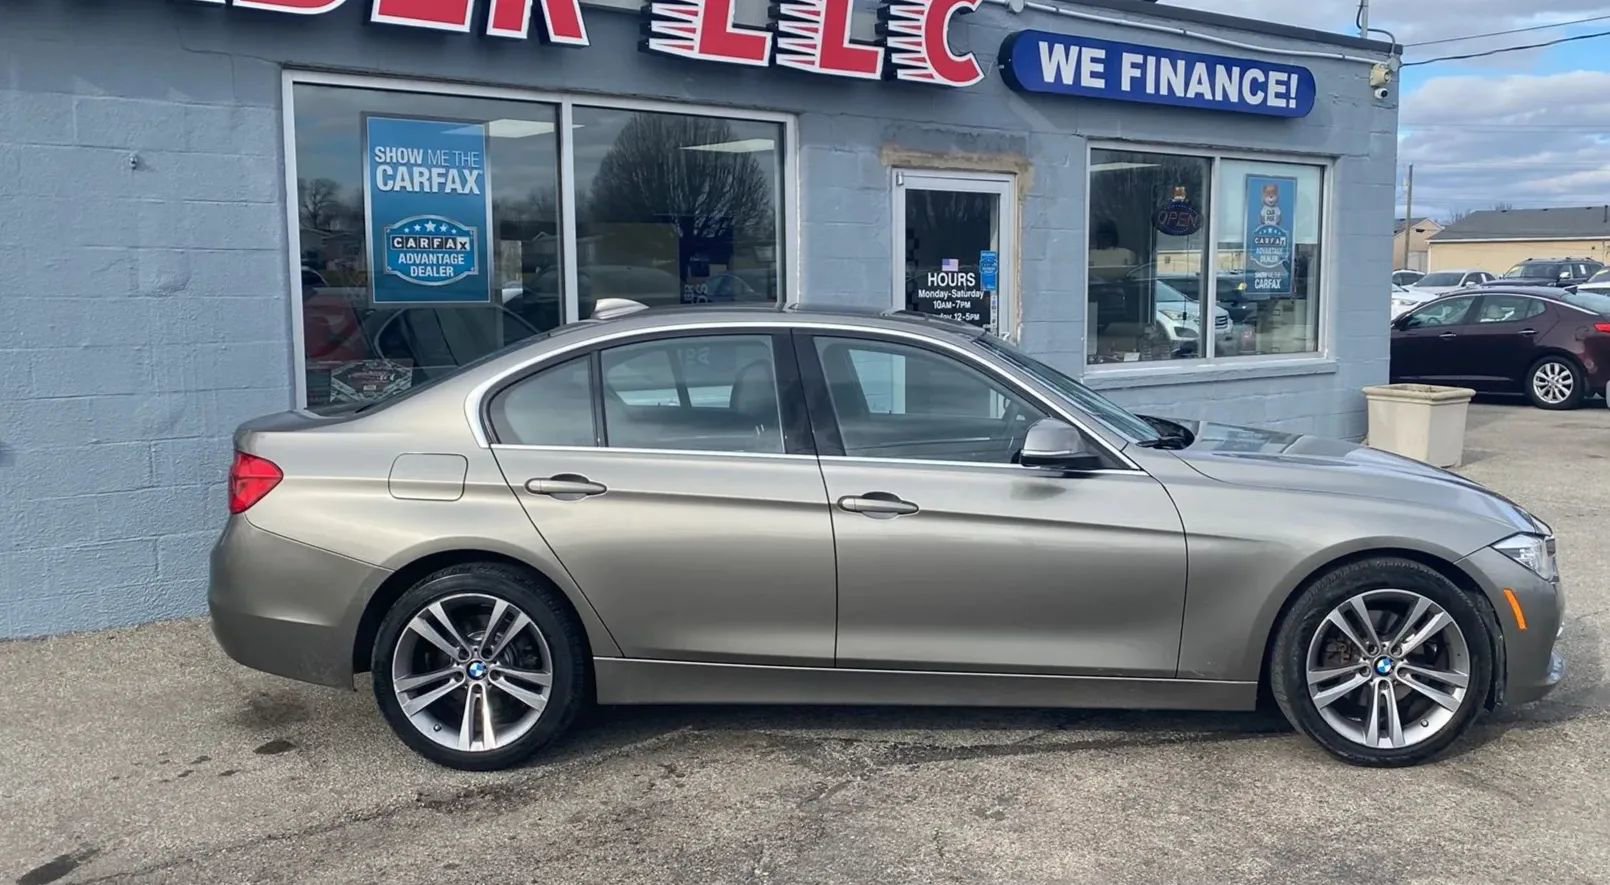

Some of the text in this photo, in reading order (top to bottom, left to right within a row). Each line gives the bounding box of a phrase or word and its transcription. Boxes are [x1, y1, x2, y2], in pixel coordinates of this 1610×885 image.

[649, 0, 985, 87] LLC
[1038, 41, 1299, 108] WE FINANCE!
[374, 146, 480, 168] SHOW ME THE
[376, 165, 481, 195] CARFAX
[1158, 210, 1200, 228] OPEN
[393, 236, 468, 250] CARFAX
[398, 252, 464, 265] ADVANTAGE
[410, 265, 454, 277] DEALER
[927, 272, 976, 287] HOURS
[1254, 279, 1282, 289] CARFAX
[918, 289, 985, 300] Monday-Saturday
[933, 300, 971, 309] 10AM-7PM
